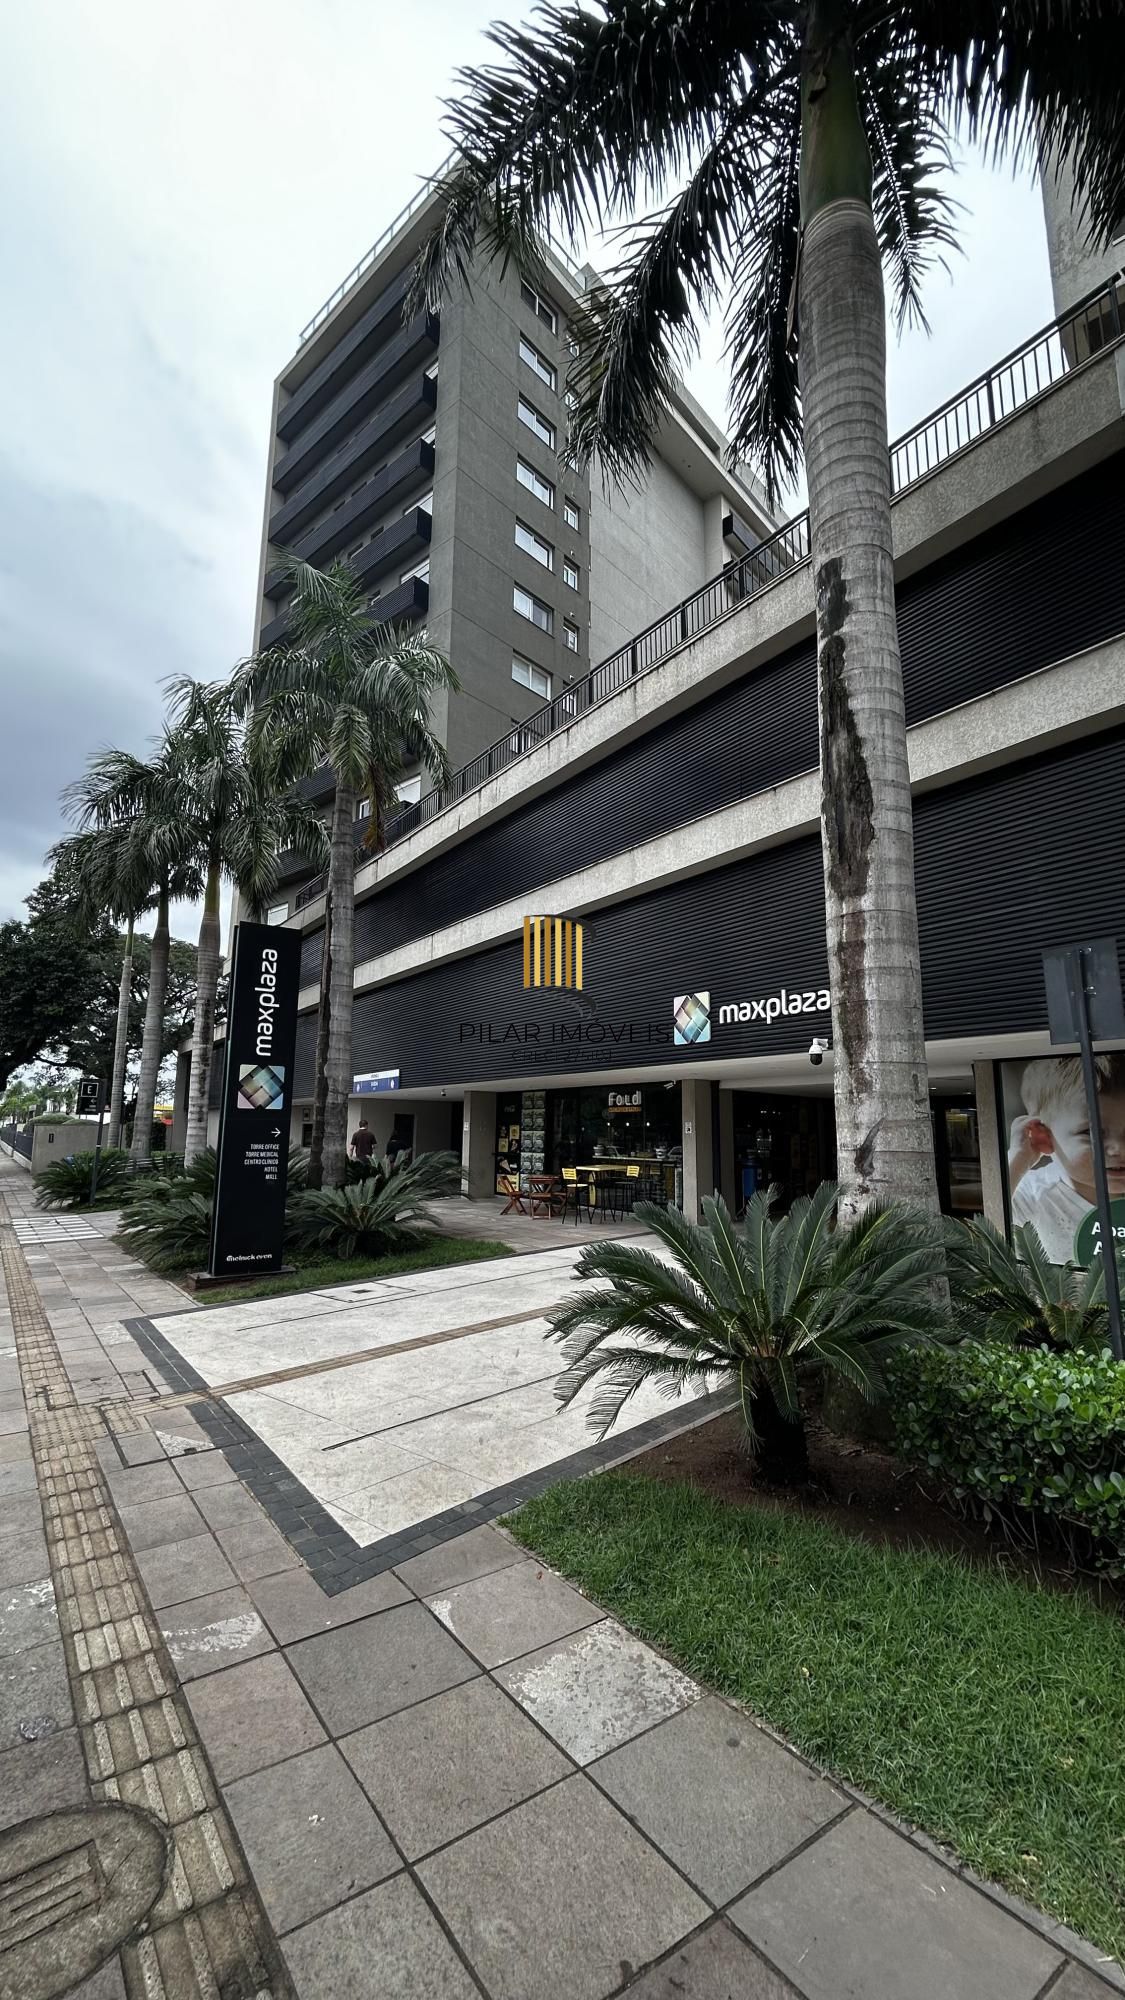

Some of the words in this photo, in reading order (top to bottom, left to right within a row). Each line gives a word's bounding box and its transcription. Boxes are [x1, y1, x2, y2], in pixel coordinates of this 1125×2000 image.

[255, 948, 280, 1057] maxplaza
[719, 989, 831, 1024] maxplaza
[87, 1085, 93, 1094] E
